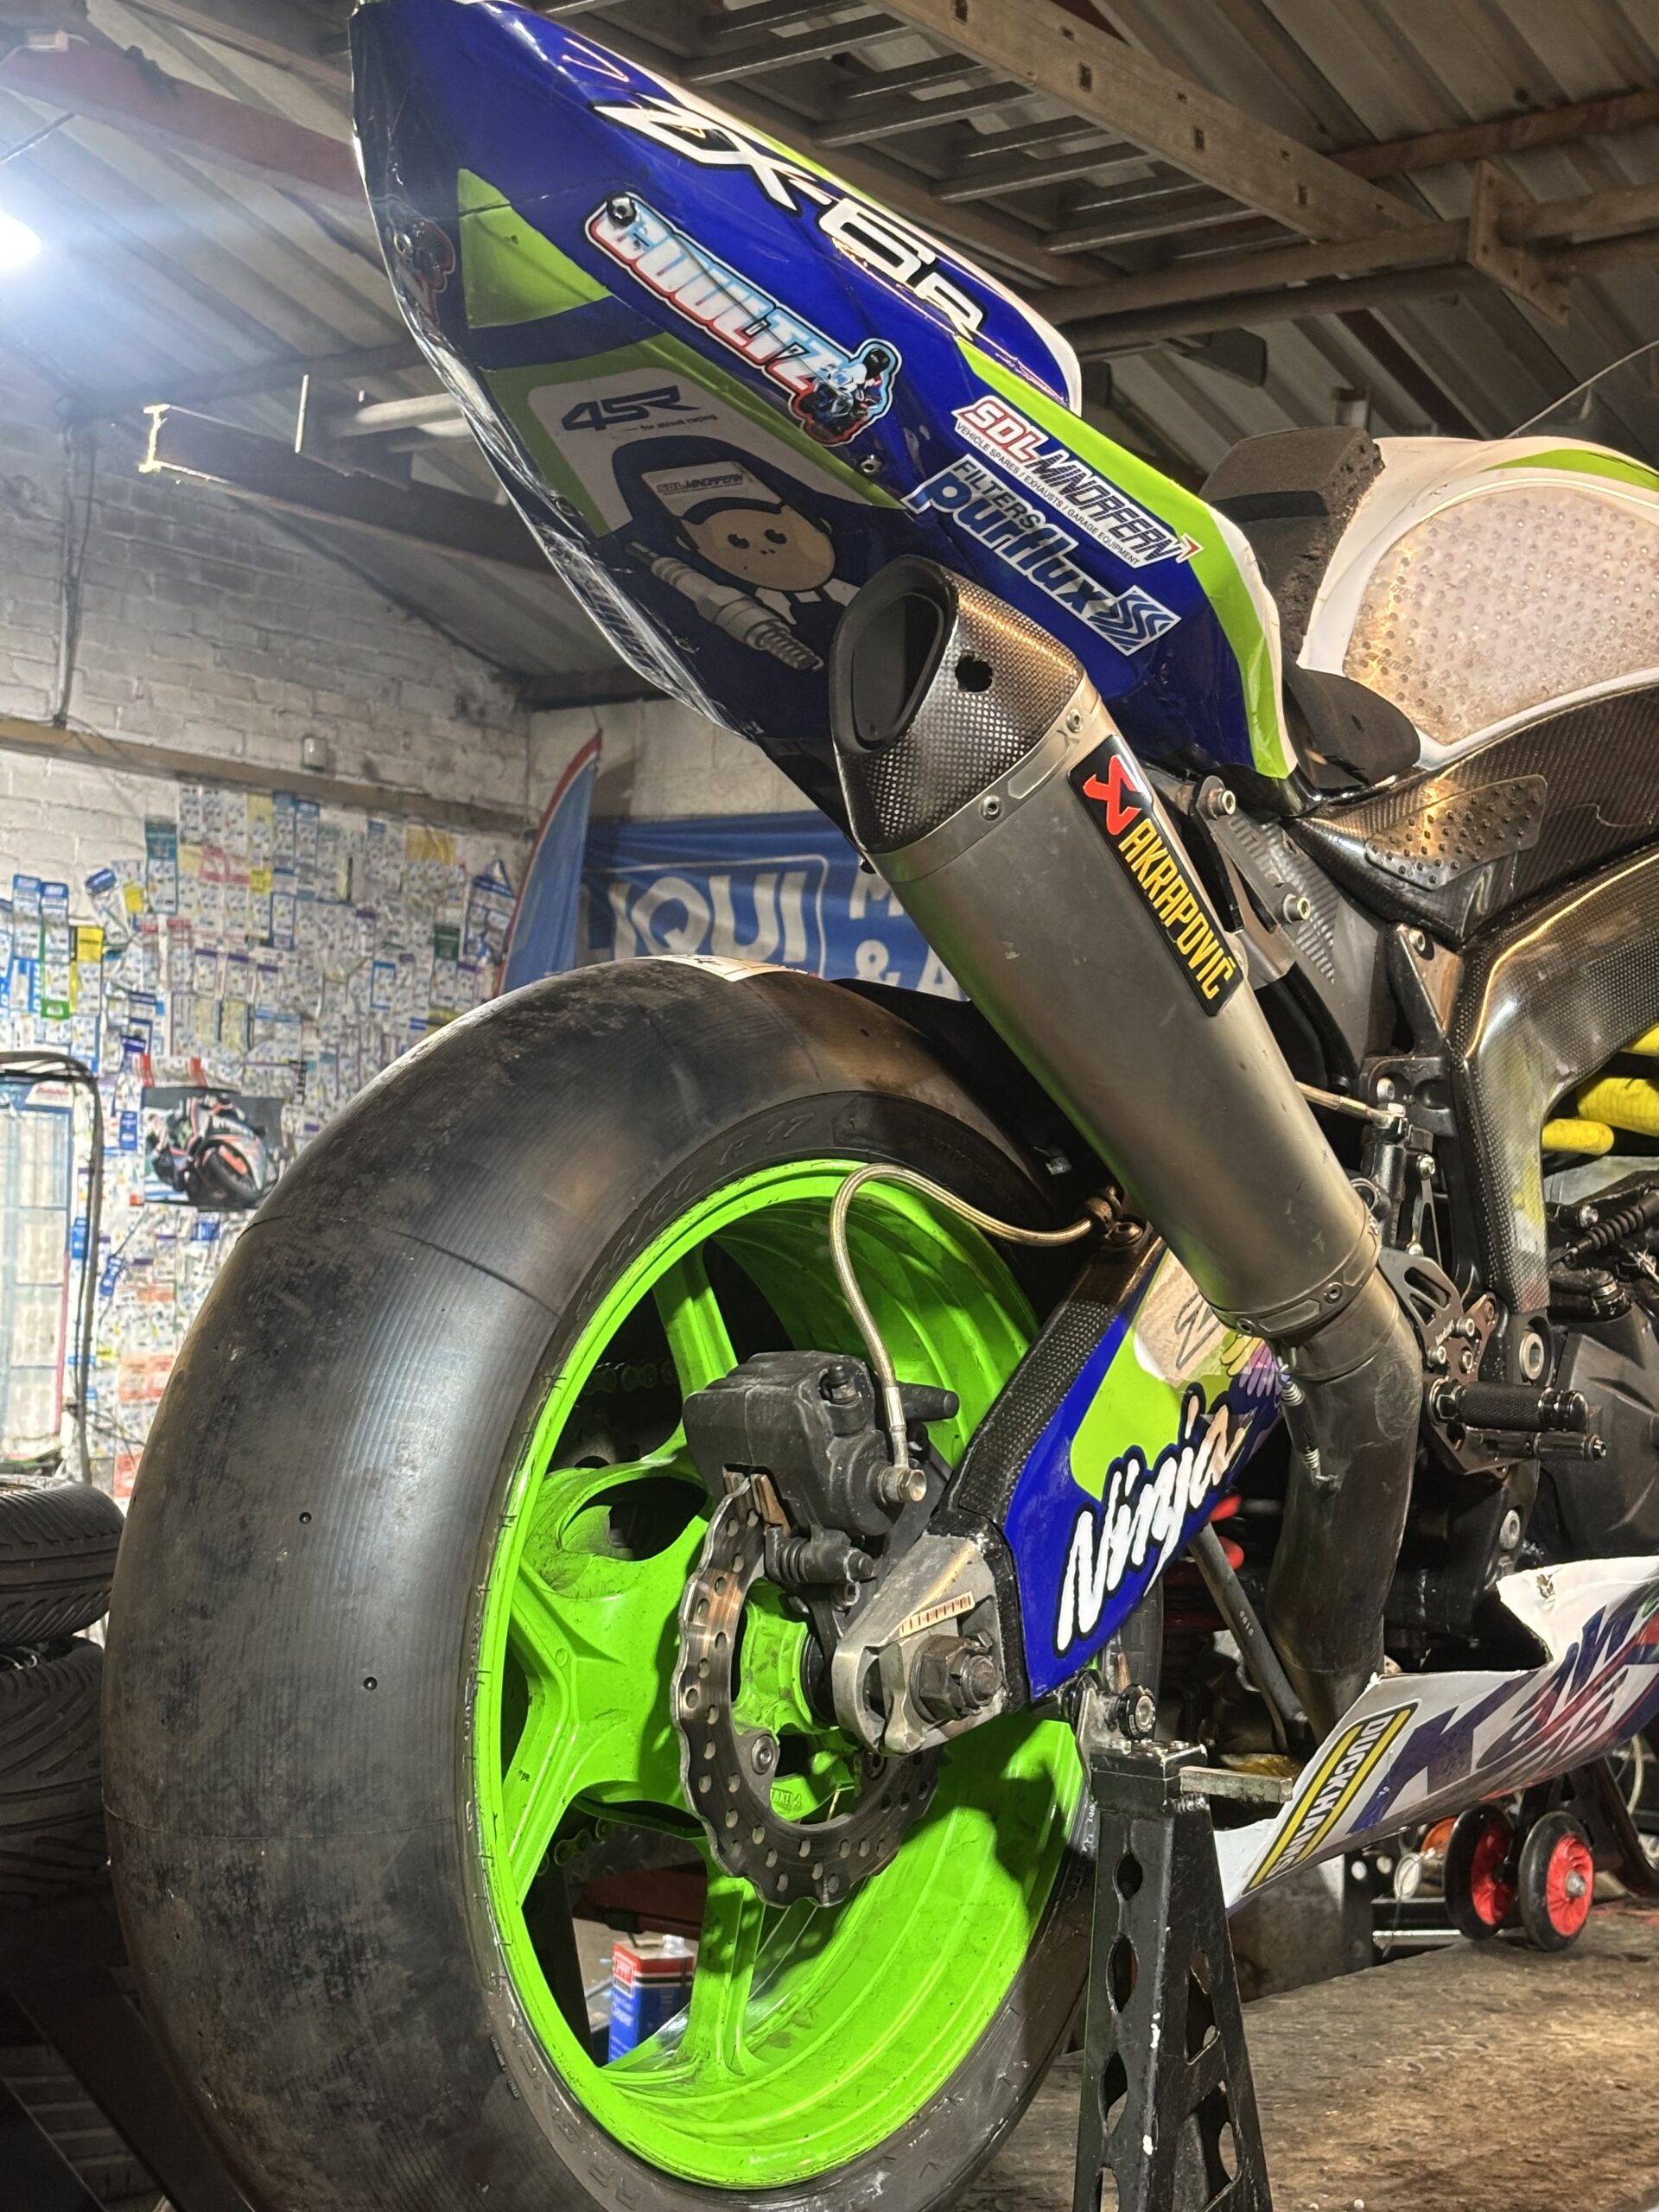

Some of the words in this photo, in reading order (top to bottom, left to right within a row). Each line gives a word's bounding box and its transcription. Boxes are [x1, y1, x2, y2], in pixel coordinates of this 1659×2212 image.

[952, 459, 1041, 529] FILTERS
[957, 422, 990, 451] VEHICLE
[989, 448, 1020, 474] SPARES
[1024, 475, 1063, 508] EXHAUSTS
[1067, 508, 1098, 537] GARAGE
[1096, 531, 1141, 567] EQUIPMENT
[960, 400, 1042, 463] SDL
[907, 472, 1111, 614] purflux
[1118, 817, 1236, 1001] AKRAPOVIČ
[1056, 1394, 1246, 1651] Ninja
